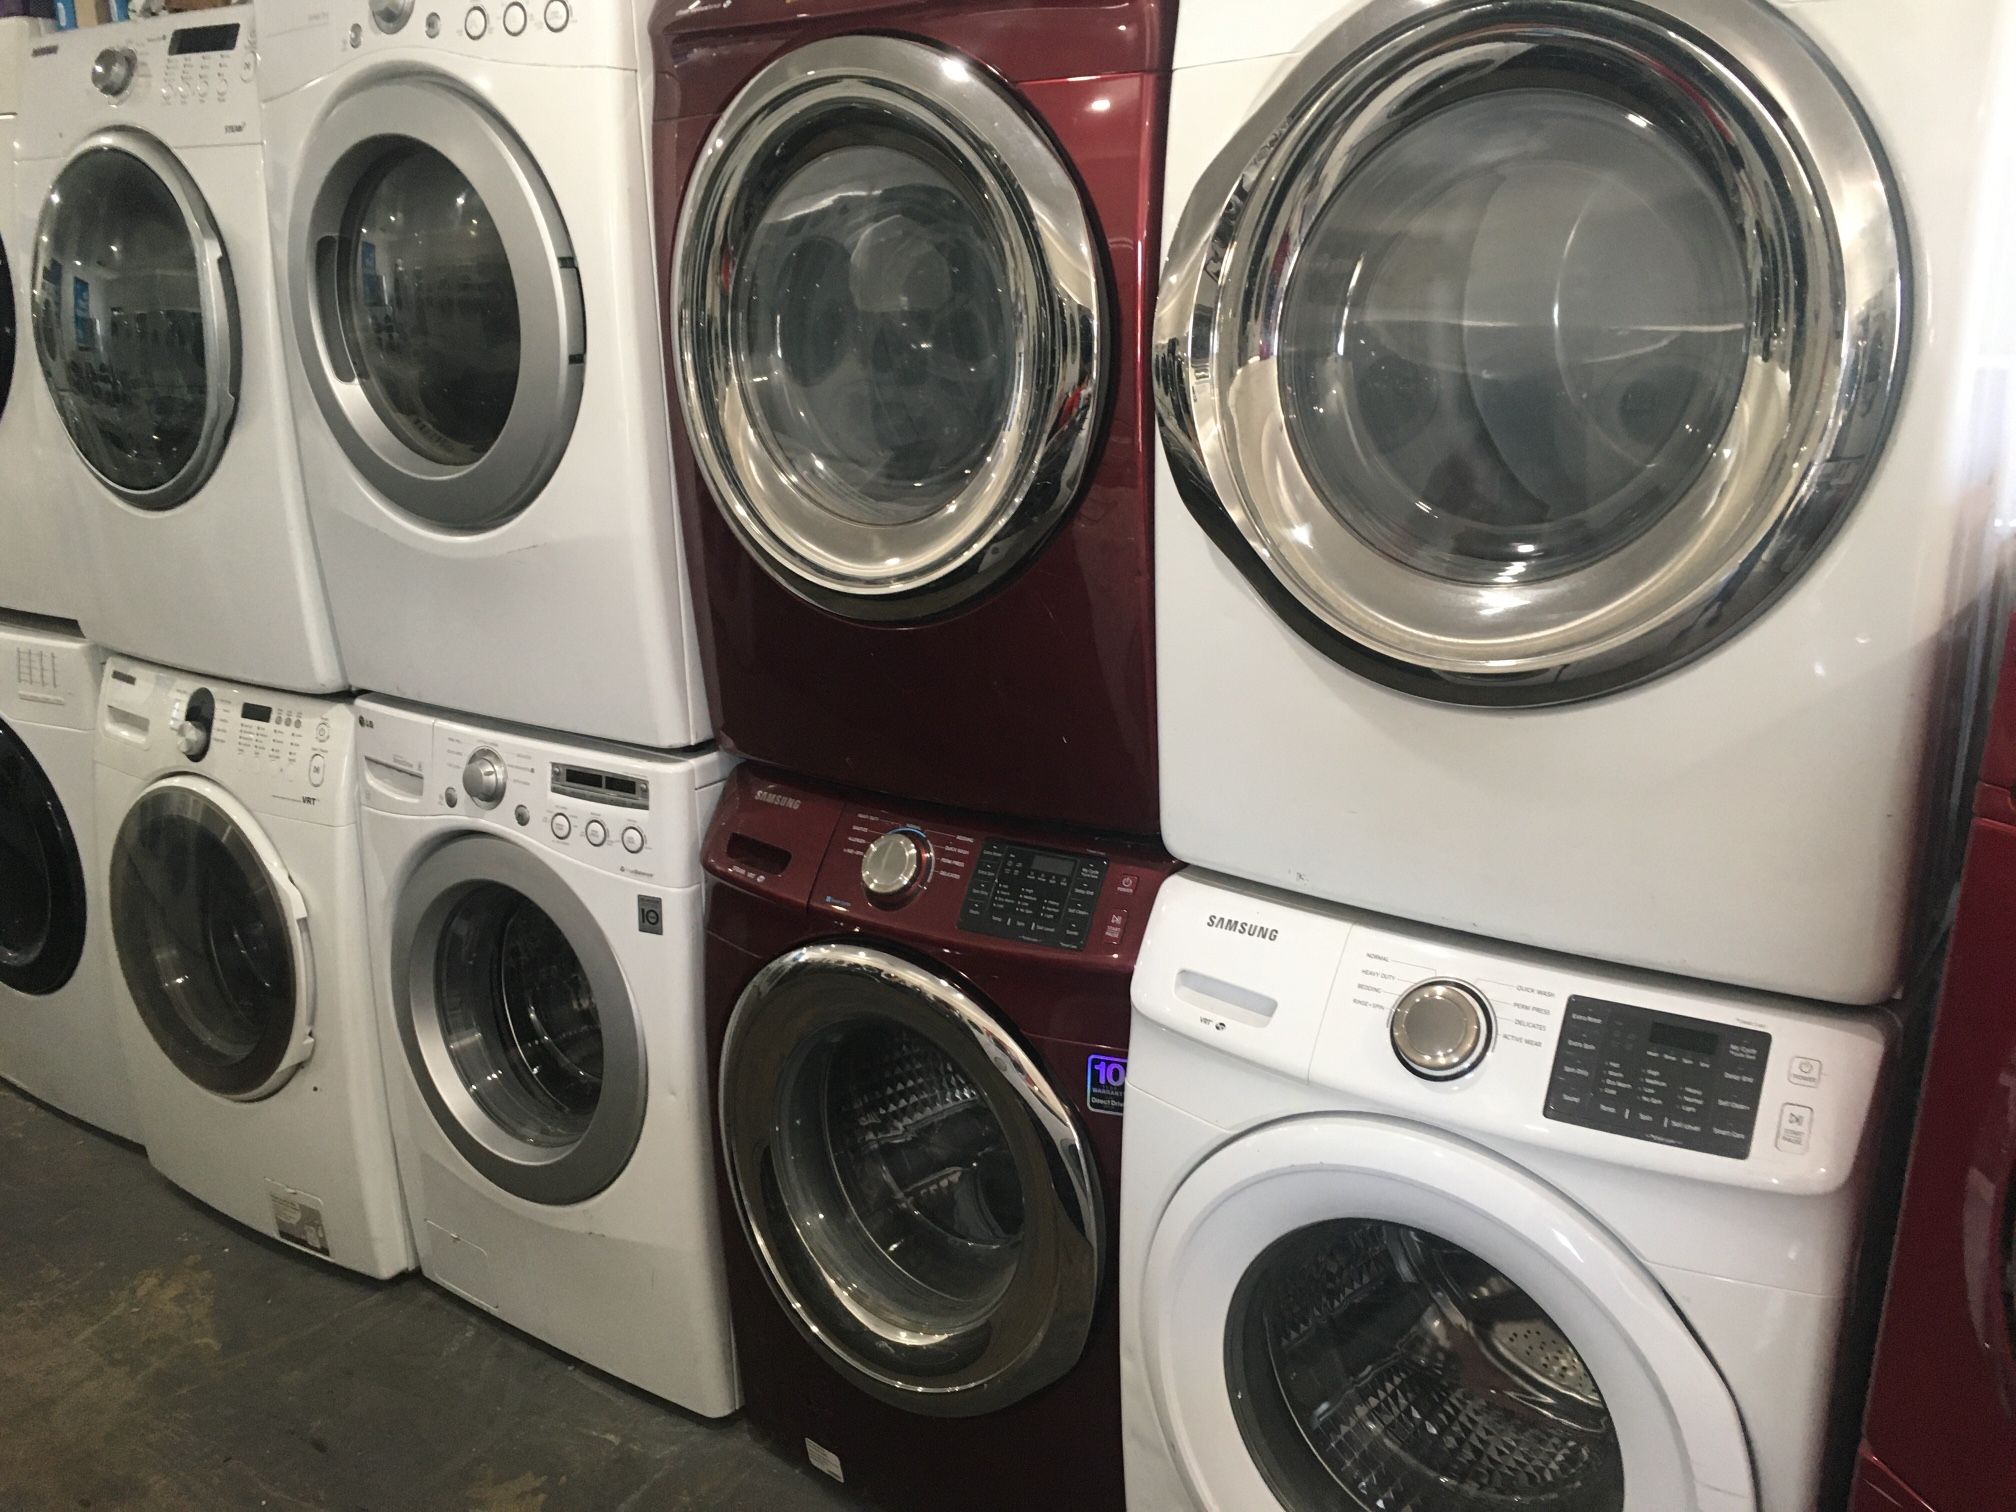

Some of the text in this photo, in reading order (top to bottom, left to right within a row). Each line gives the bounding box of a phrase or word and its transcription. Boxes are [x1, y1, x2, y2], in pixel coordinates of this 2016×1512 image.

[302, 796, 316, 806] VRT
[755, 790, 802, 810] SAMSUNG
[1207, 915, 1279, 941] SAMSUNG
[1366, 952, 1389, 963] NORMAL
[1362, 969, 1396, 981] HEAVY DUTY
[1357, 983, 1382, 994] BEDDING
[1516, 984, 1555, 998] QUICK WASH
[1513, 1002, 1551, 1016] PERM PRESS
[1514, 1018, 1547, 1031] DELICATES
[1502, 1033, 1542, 1048] ACTIVE WEAR
[1094, 1061, 1125, 1086] 10
[1092, 1088, 1124, 1097] WARRANT
[1091, 1097, 1110, 1105] Direct
